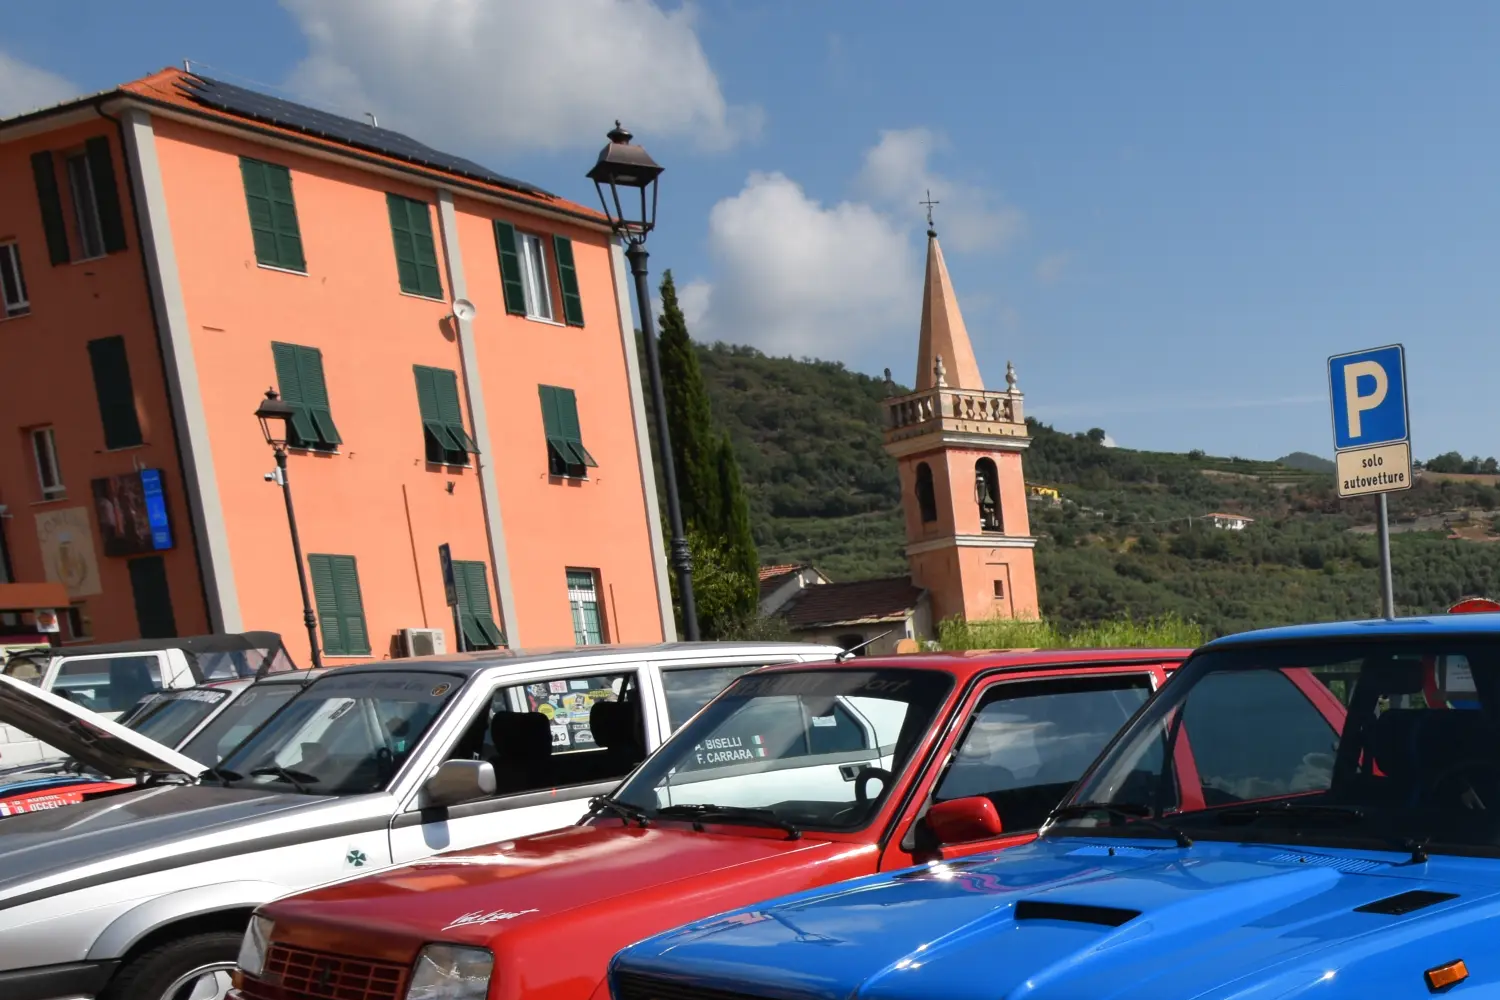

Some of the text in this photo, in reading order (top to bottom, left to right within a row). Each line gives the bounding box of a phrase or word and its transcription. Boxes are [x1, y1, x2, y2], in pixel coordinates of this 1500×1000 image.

[1344, 361, 1388, 438] P
[1362, 454, 1383, 468] solo
[1344, 472, 1404, 489] autovetture
[706, 736, 742, 750] BISELLI
[697, 748, 753, 764] F. CARRARA
